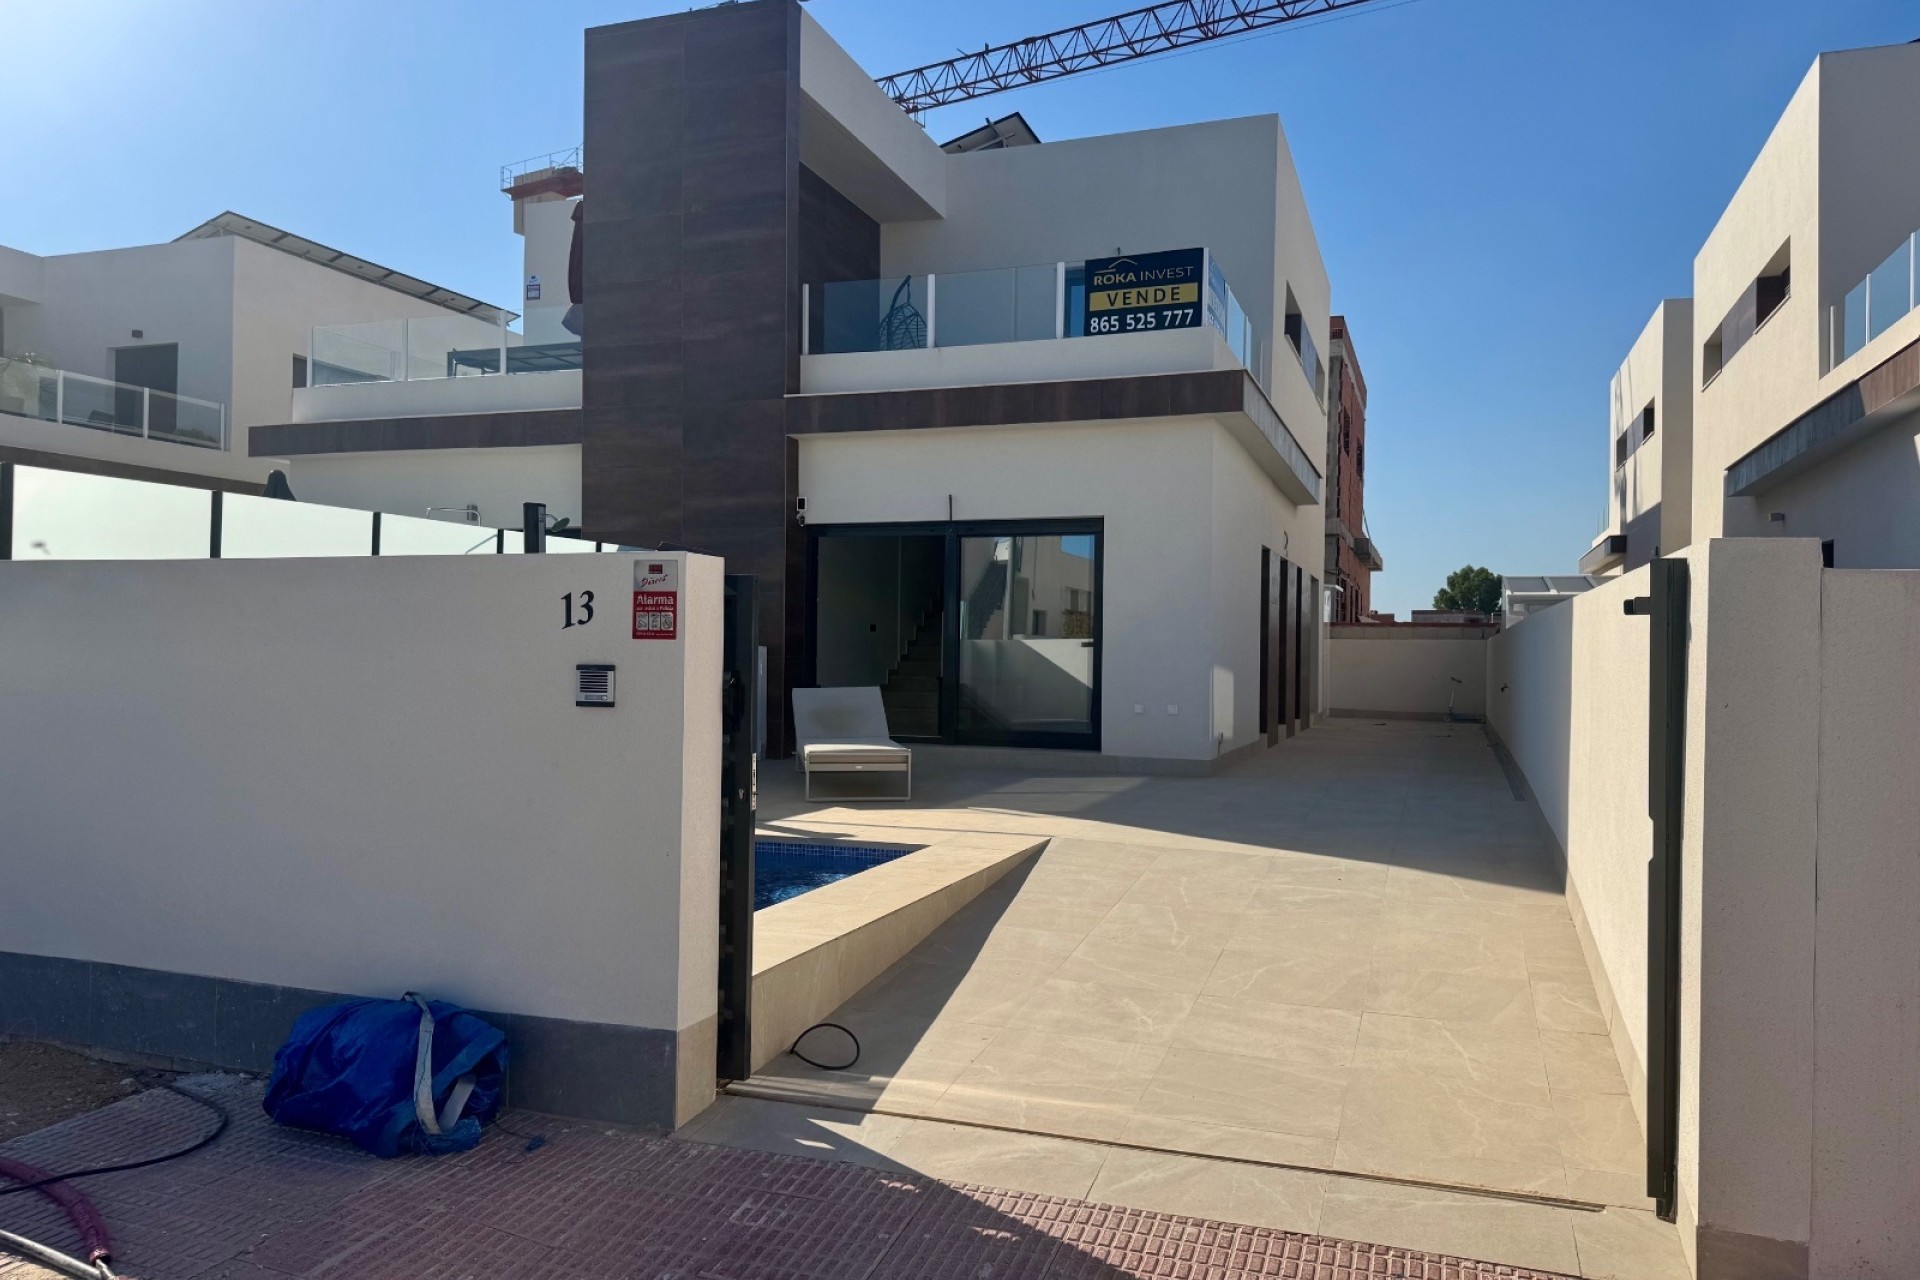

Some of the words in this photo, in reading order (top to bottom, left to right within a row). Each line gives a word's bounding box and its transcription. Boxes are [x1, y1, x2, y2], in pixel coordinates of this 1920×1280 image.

[1093, 272, 1137, 286] ROKA
[1140, 266, 1194, 281] INVEST
[1107, 286, 1180, 307] VENDE
[1090, 315, 1119, 333] 865
[1126, 312, 1156, 330] 525
[1163, 309, 1194, 327] 777
[560, 590, 595, 630] 13
[636, 594, 674, 605] Alarma
